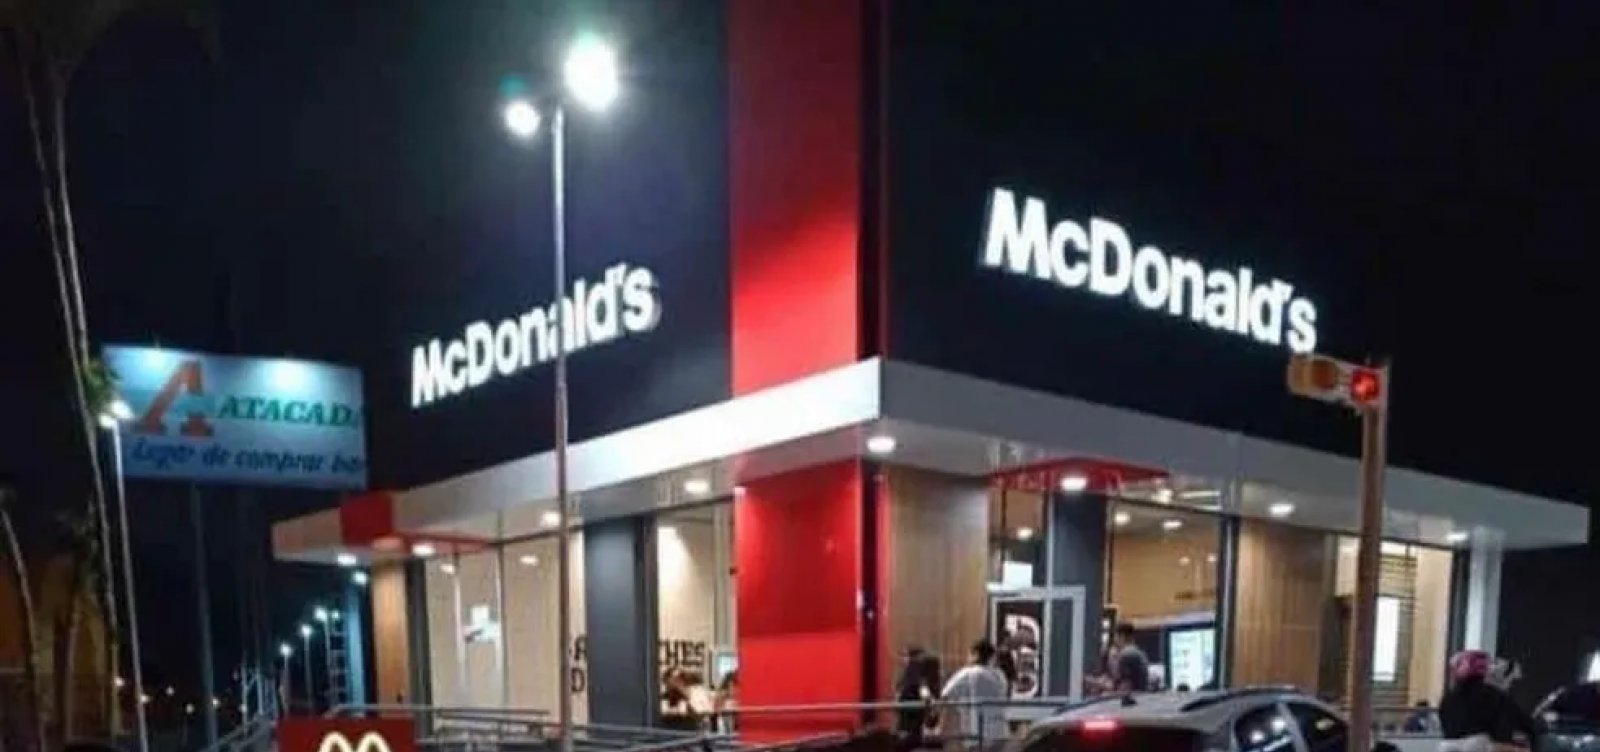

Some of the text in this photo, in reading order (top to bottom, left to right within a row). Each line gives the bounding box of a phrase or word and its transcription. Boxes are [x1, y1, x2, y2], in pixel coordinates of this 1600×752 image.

[981, 187, 1317, 354] McDonald's
[411, 262, 660, 408] McDonald's
[201, 443, 231, 468] de
[217, 396, 363, 428] ATACAD
